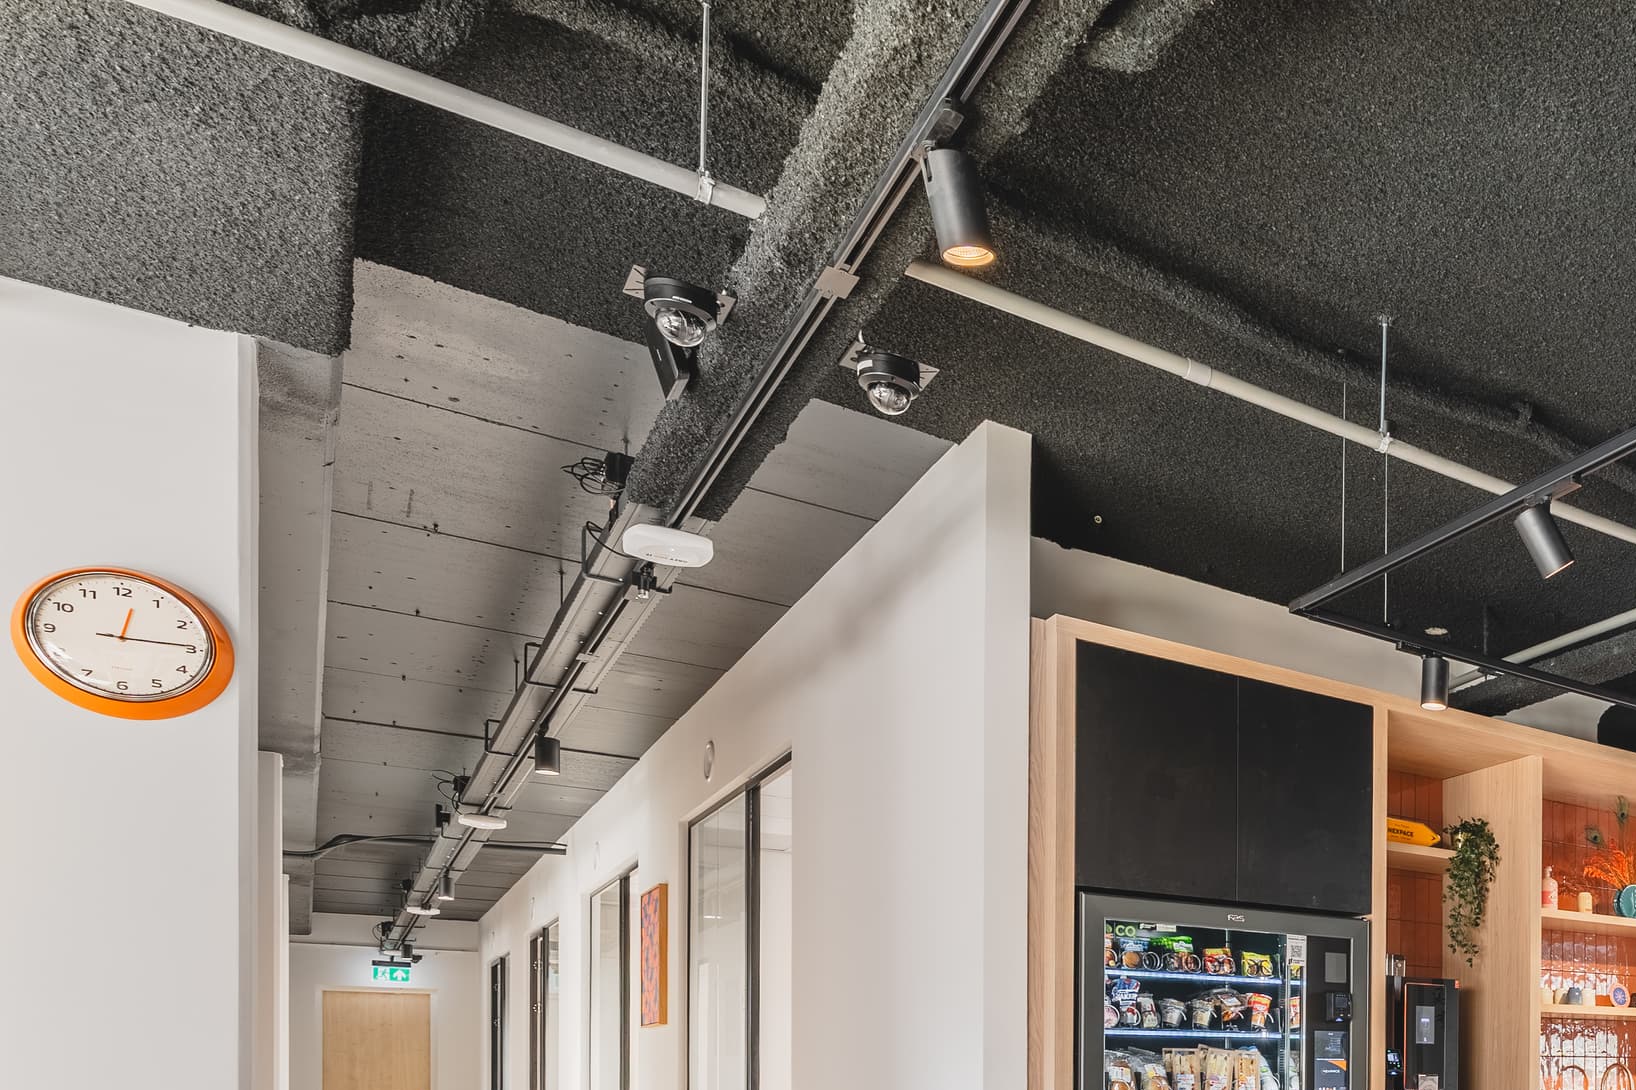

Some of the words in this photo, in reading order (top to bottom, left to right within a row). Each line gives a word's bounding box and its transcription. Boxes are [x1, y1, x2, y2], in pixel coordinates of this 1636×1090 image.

[79, 588, 97, 600] 11
[112, 586, 133, 598] 12
[52, 601, 74, 613] 10
[152, 599, 160, 609] 1
[43, 623, 56, 633] 9
[176, 619, 188, 630] 2
[185, 644, 197, 654] 3
[81, 668, 93, 677] 7
[175, 665, 189, 674] 4
[116, 680, 129, 691] 6
[151, 678, 162, 688] 5
